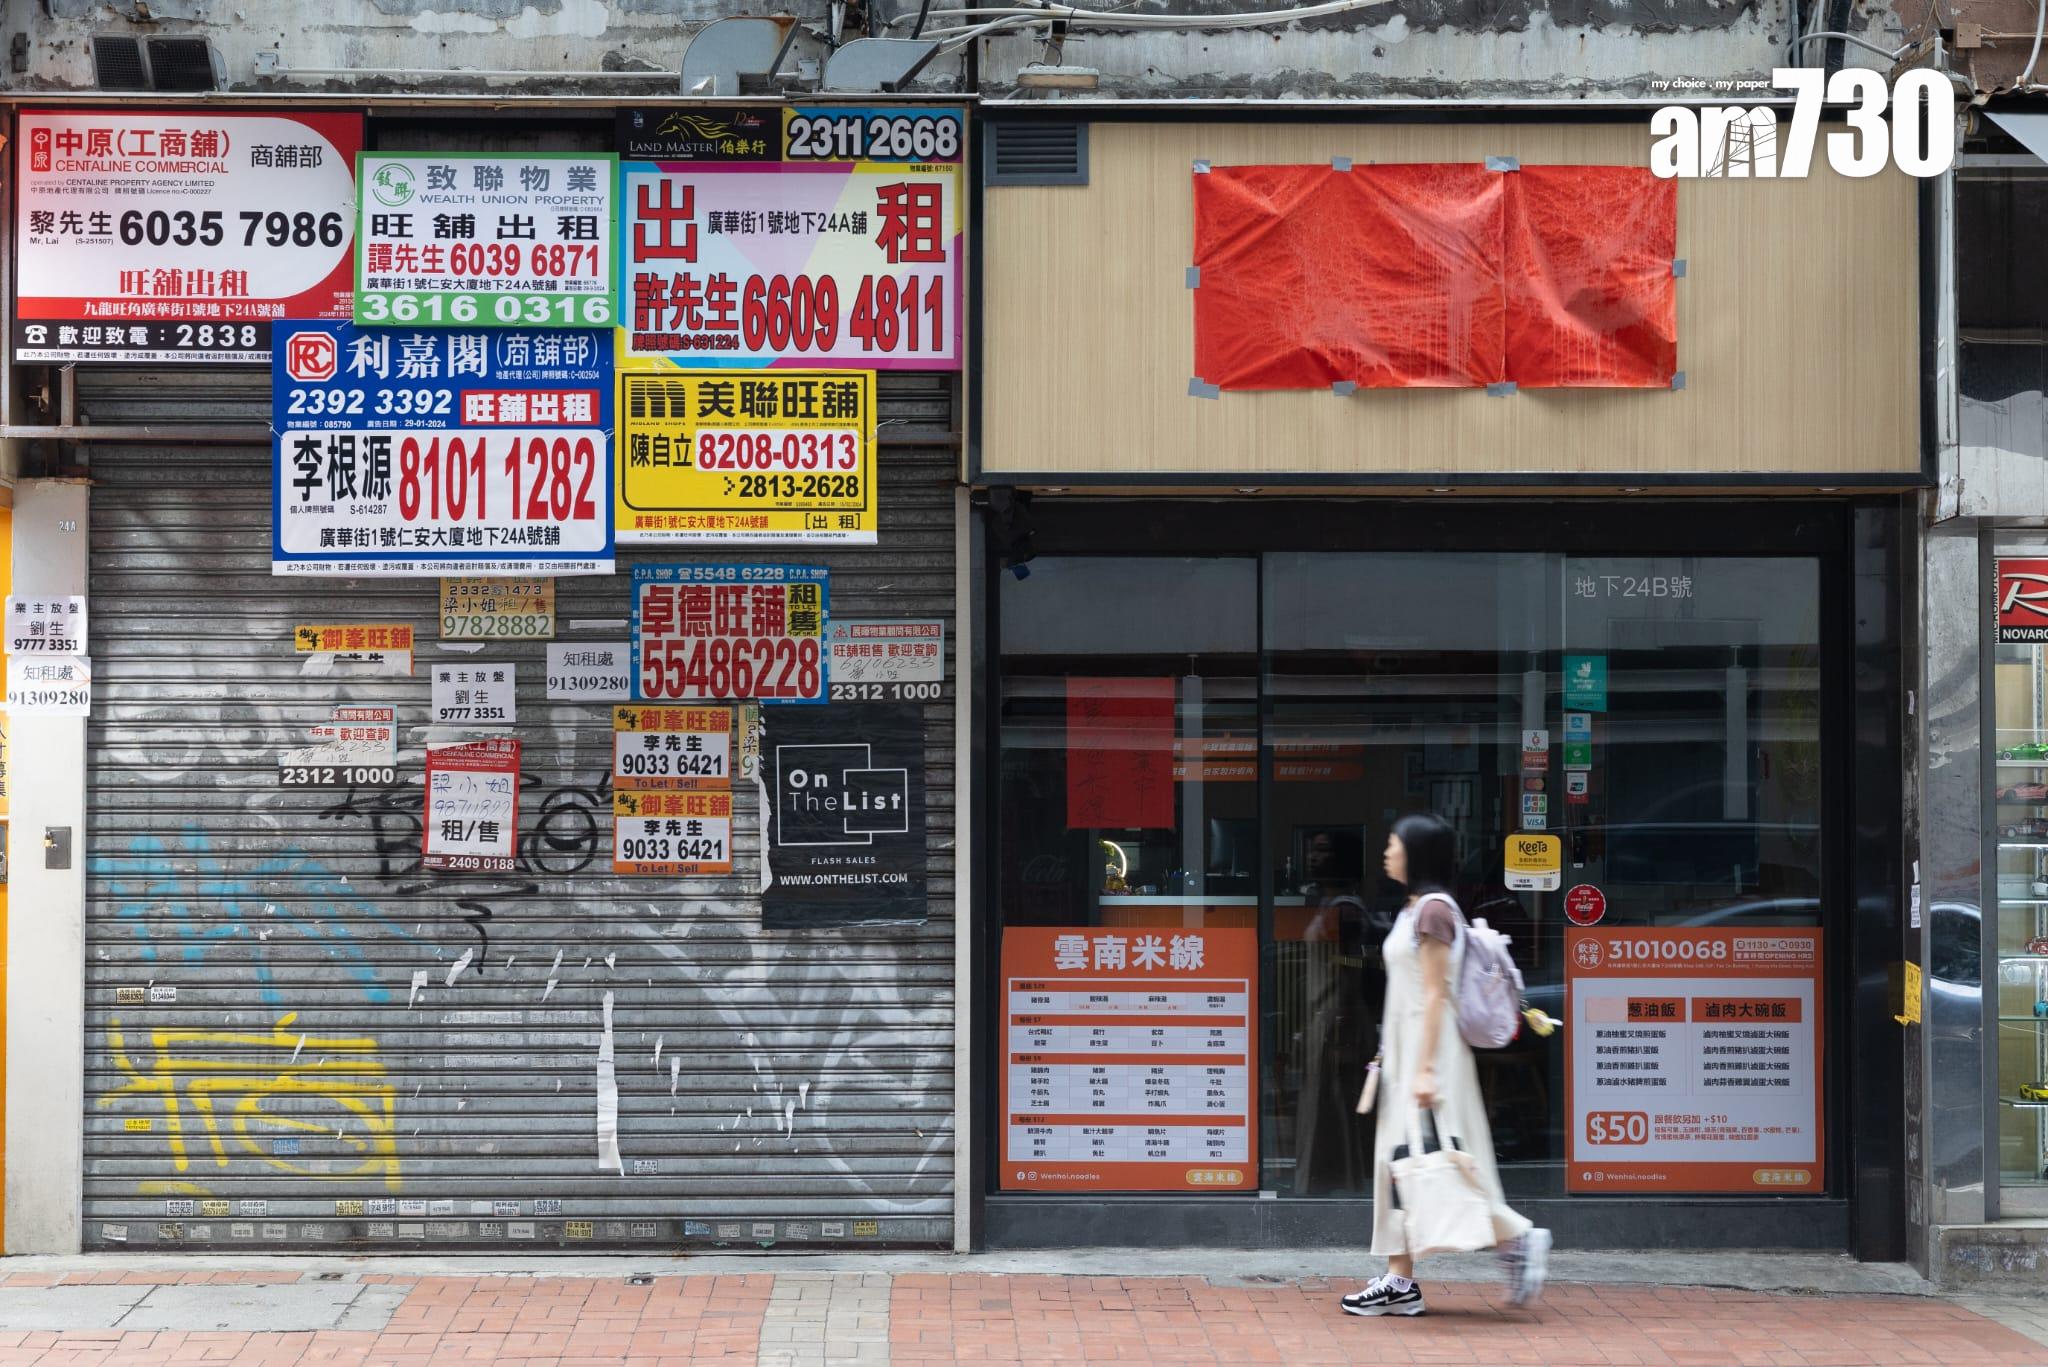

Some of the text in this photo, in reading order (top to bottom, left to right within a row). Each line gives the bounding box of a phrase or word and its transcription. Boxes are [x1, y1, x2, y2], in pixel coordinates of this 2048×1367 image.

[55, 128, 230, 158] 中原(工商舖)
[789, 115, 958, 157] 2311 2668
[56, 160, 229, 173] CENTALINE COMMERCIAL
[250, 145, 322, 168] 商舖部
[427, 164, 597, 192] 致聯物業
[420, 195, 604, 205] WEALTH UNION PROPERTY
[30, 210, 343, 247] 黎先生 6035 7986
[372, 214, 599, 240] 旺舖出租
[633, 179, 698, 263] 出
[707, 211, 868, 235] 廣華街1號地下24A舖
[875, 182, 946, 264] 租
[46, 237, 59, 245] Lai
[368, 243, 599, 277] 譚先生 6039 6871
[119, 269, 249, 297] 旺舖出租
[362, 295, 478, 321] 3616
[494, 296, 610, 323] 0316
[634, 272, 943, 352] 許先生 6609 4811
[176, 324, 257, 346] 2838
[346, 334, 599, 379] 利嘉閣 (商舖部)
[287, 389, 453, 415] 2392 3392
[465, 394, 592, 422] 旺舖出租
[697, 381, 859, 419] 美聯旺舖
[631, 433, 855, 470] 陳自立 8208-0313
[292, 434, 595, 521] 李根源 8101 1282
[739, 475, 859, 498] 2813-2628
[350, 505, 387, 515] S-614287
[320, 527, 561, 547] 廣華街1號仁安大廈地下24A號舖
[656, 569, 673, 579] SHOP
[694, 568, 736, 580] 5548
[742, 568, 784, 579] 6228
[811, 570, 827, 579] SHOP
[450, 586, 542, 595] 2332 1473
[790, 584, 816, 604] 租
[1575, 576, 1692, 598] 地下24B號
[444, 598, 497, 613] 梁小姐
[642, 584, 785, 637] 卓德旺舖
[30, 621, 64, 636] 劉生
[444, 616, 550, 635] 97828882
[790, 611, 817, 631] 售
[14, 639, 78, 650] 9777 3351
[322, 627, 410, 649] 御峯旺舖
[563, 651, 614, 667] 知租處
[888, 644, 937, 656] 歡迎查詢
[24, 665, 73, 680] 知租處
[439, 672, 505, 683] 業主放盤
[643, 638, 819, 698] 55486228
[549, 676, 629, 691] 91309280
[831, 683, 941, 700] 2312 1000
[9, 691, 88, 705] 91309280
[455, 690, 488, 704] 劉生
[440, 708, 505, 719] 9777 3351
[640, 710, 729, 731] 御峯旺舖
[644, 735, 702, 751] 李先生
[623, 754, 721, 775] 9033 6421
[283, 768, 394, 783] 2312 1000
[635, 780, 697, 788] To Let Sell
[789, 769, 828, 788] On
[641, 794, 730, 817] 御峯旺舖
[441, 820, 499, 843] 租/售
[644, 820, 703, 837] 李先生
[623, 839, 722, 861] 9033 6421
[1519, 841, 1547, 855] KeeTa
[449, 857, 479, 868] 2409
[484, 858, 514, 869] 0188
[635, 864, 699, 873] To Let Sell
[811, 856, 876, 865] FLASH SALES
[780, 873, 908, 885] WWW.ONTHELIST.COM
[1055, 934, 1205, 971] 雲南米線
[1608, 940, 1727, 959] 31010068
[1590, 1114, 1646, 1145] $50
